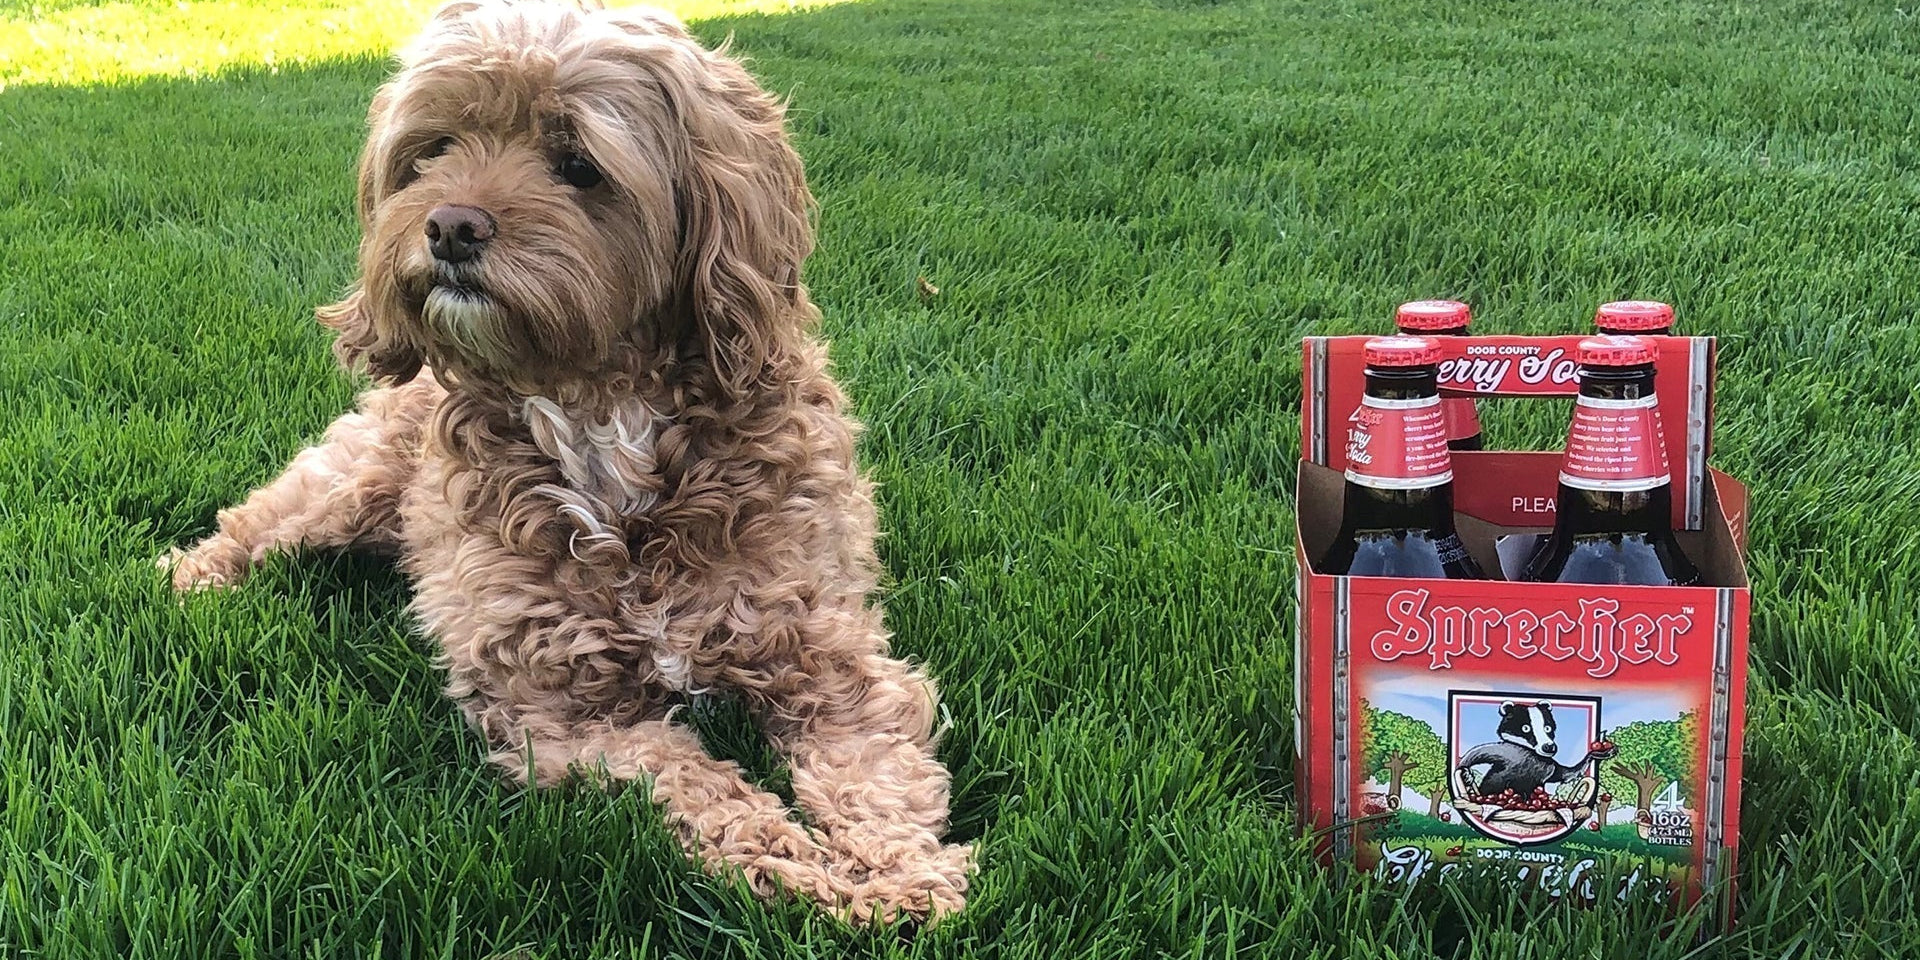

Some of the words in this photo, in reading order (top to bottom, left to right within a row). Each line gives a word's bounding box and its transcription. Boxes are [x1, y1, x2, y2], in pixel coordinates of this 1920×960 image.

[1467, 346, 1496, 355] DOOR
[1498, 346, 1541, 355] COUNTY
[1615, 435, 1627, 443] just
[1512, 497, 1557, 512] PLEA
[1371, 588, 1693, 678] Sprecher
[1652, 780, 1686, 812] 4
[1648, 836, 1692, 846] BOTTLES
